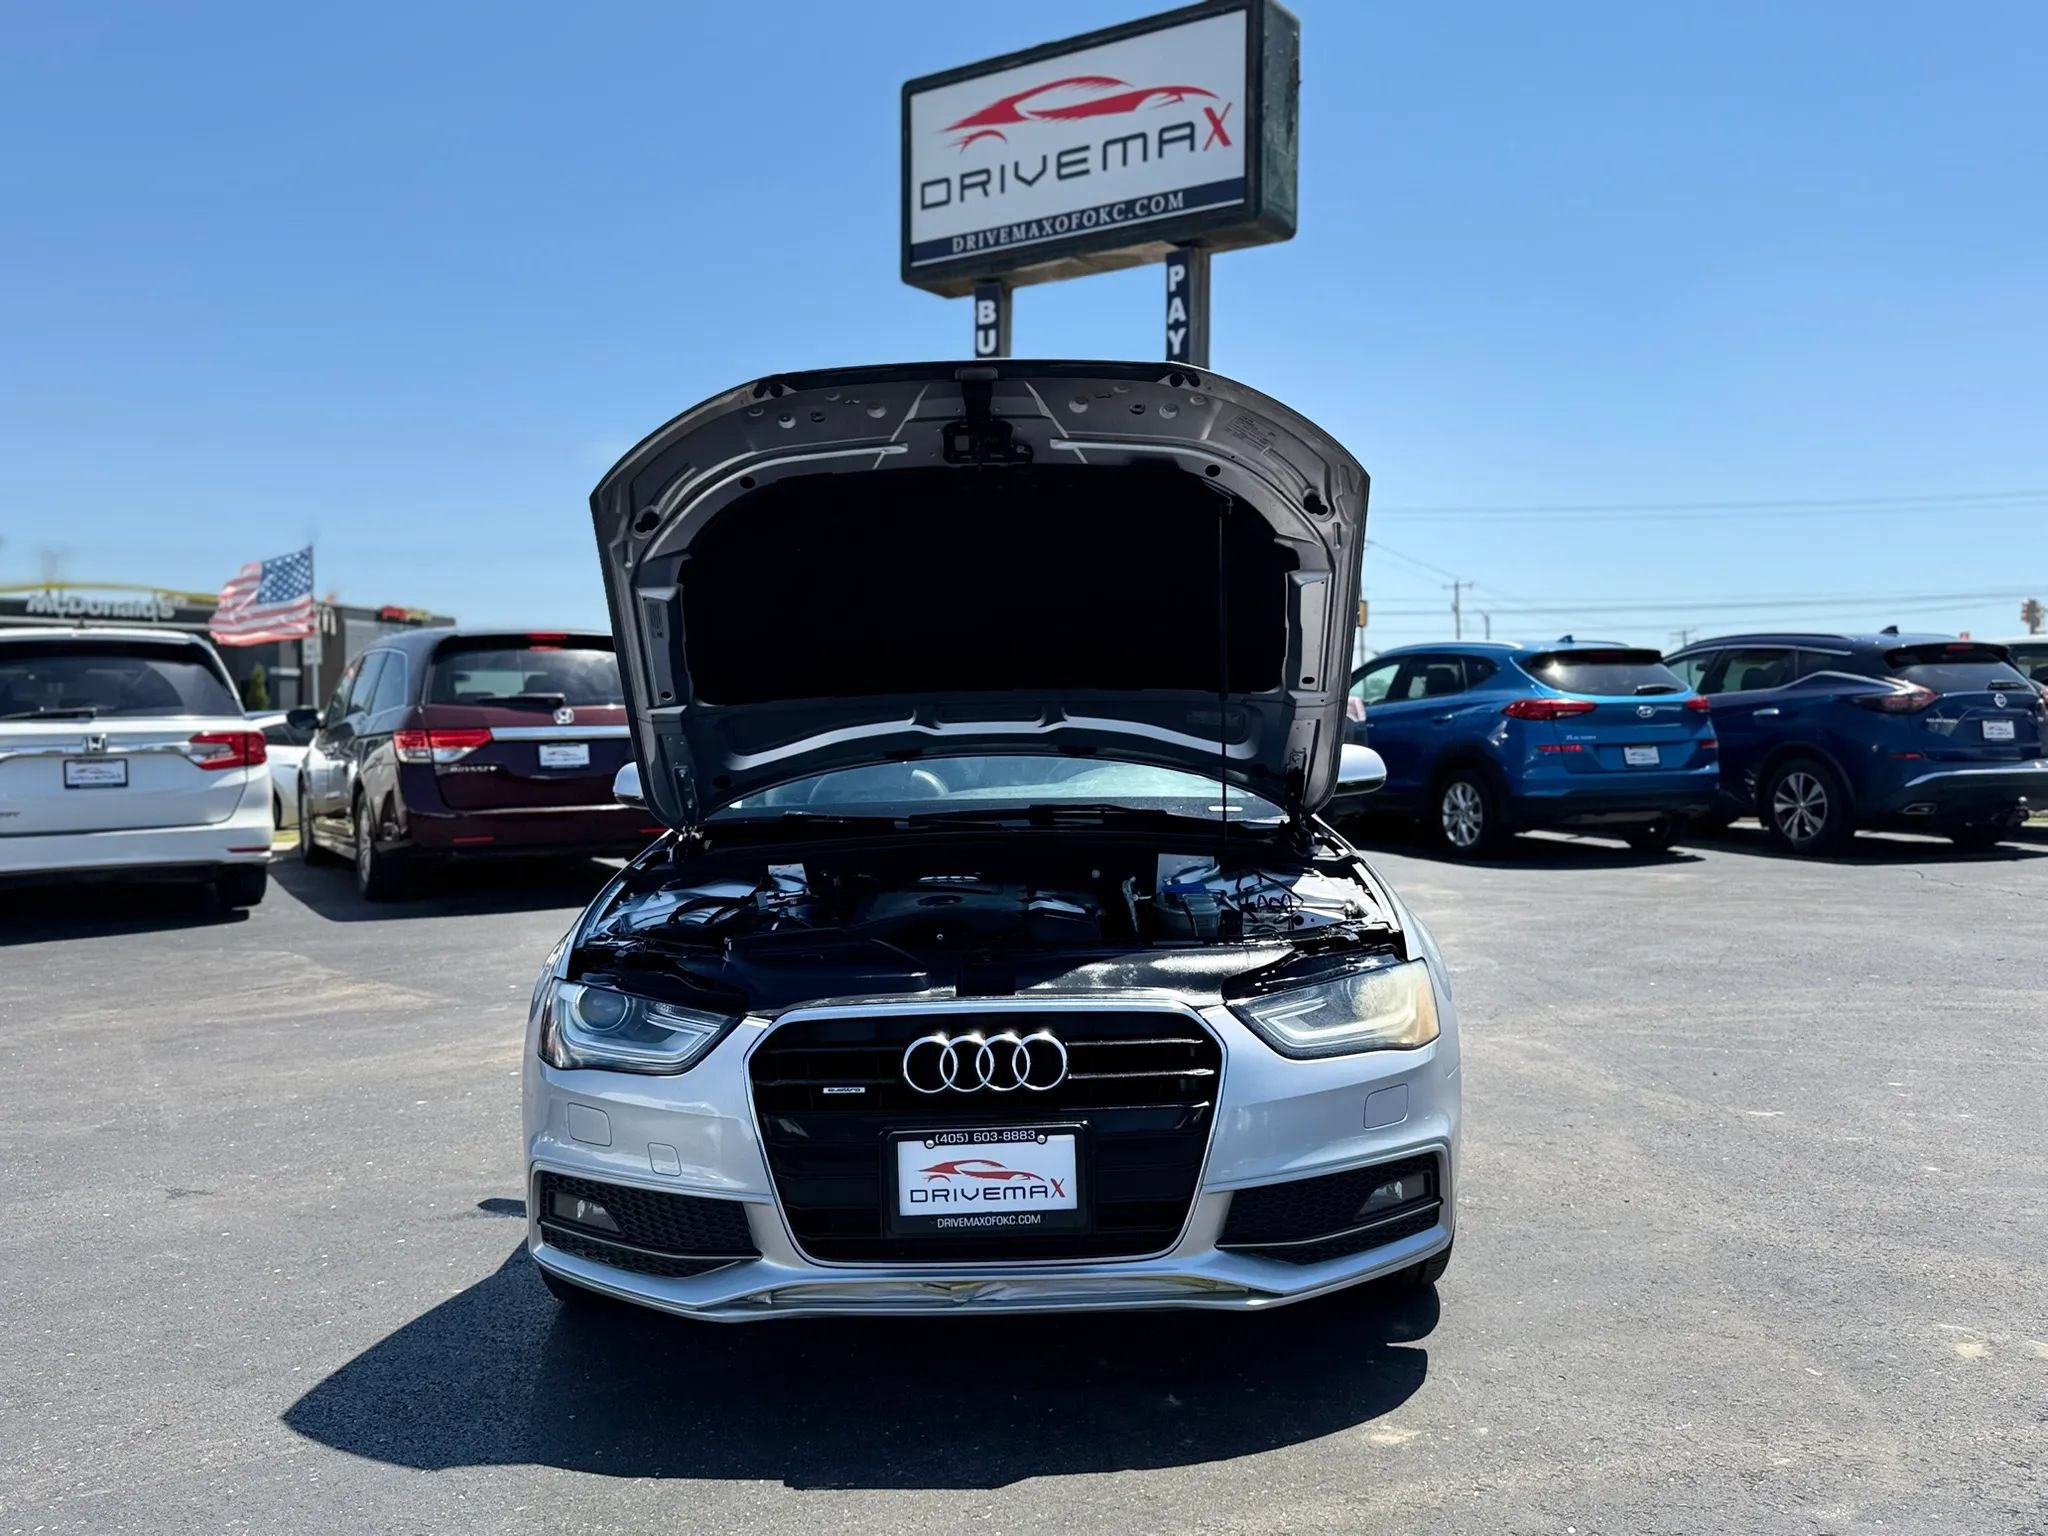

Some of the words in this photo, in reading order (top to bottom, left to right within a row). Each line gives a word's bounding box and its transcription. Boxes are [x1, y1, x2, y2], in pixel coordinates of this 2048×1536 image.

[920, 101, 1233, 211] DRIVEMAX
[951, 192, 1185, 253] DRIVEMAXOFOKC.COM
[1167, 264, 1187, 356] PAY
[935, 1132, 969, 1145] (405)
[973, 1130, 1036, 1143] 603-8883
[910, 1177, 1066, 1204] DRIVEMAX
[936, 1213, 1042, 1229] DRIVEMAXOFOKC.COM
